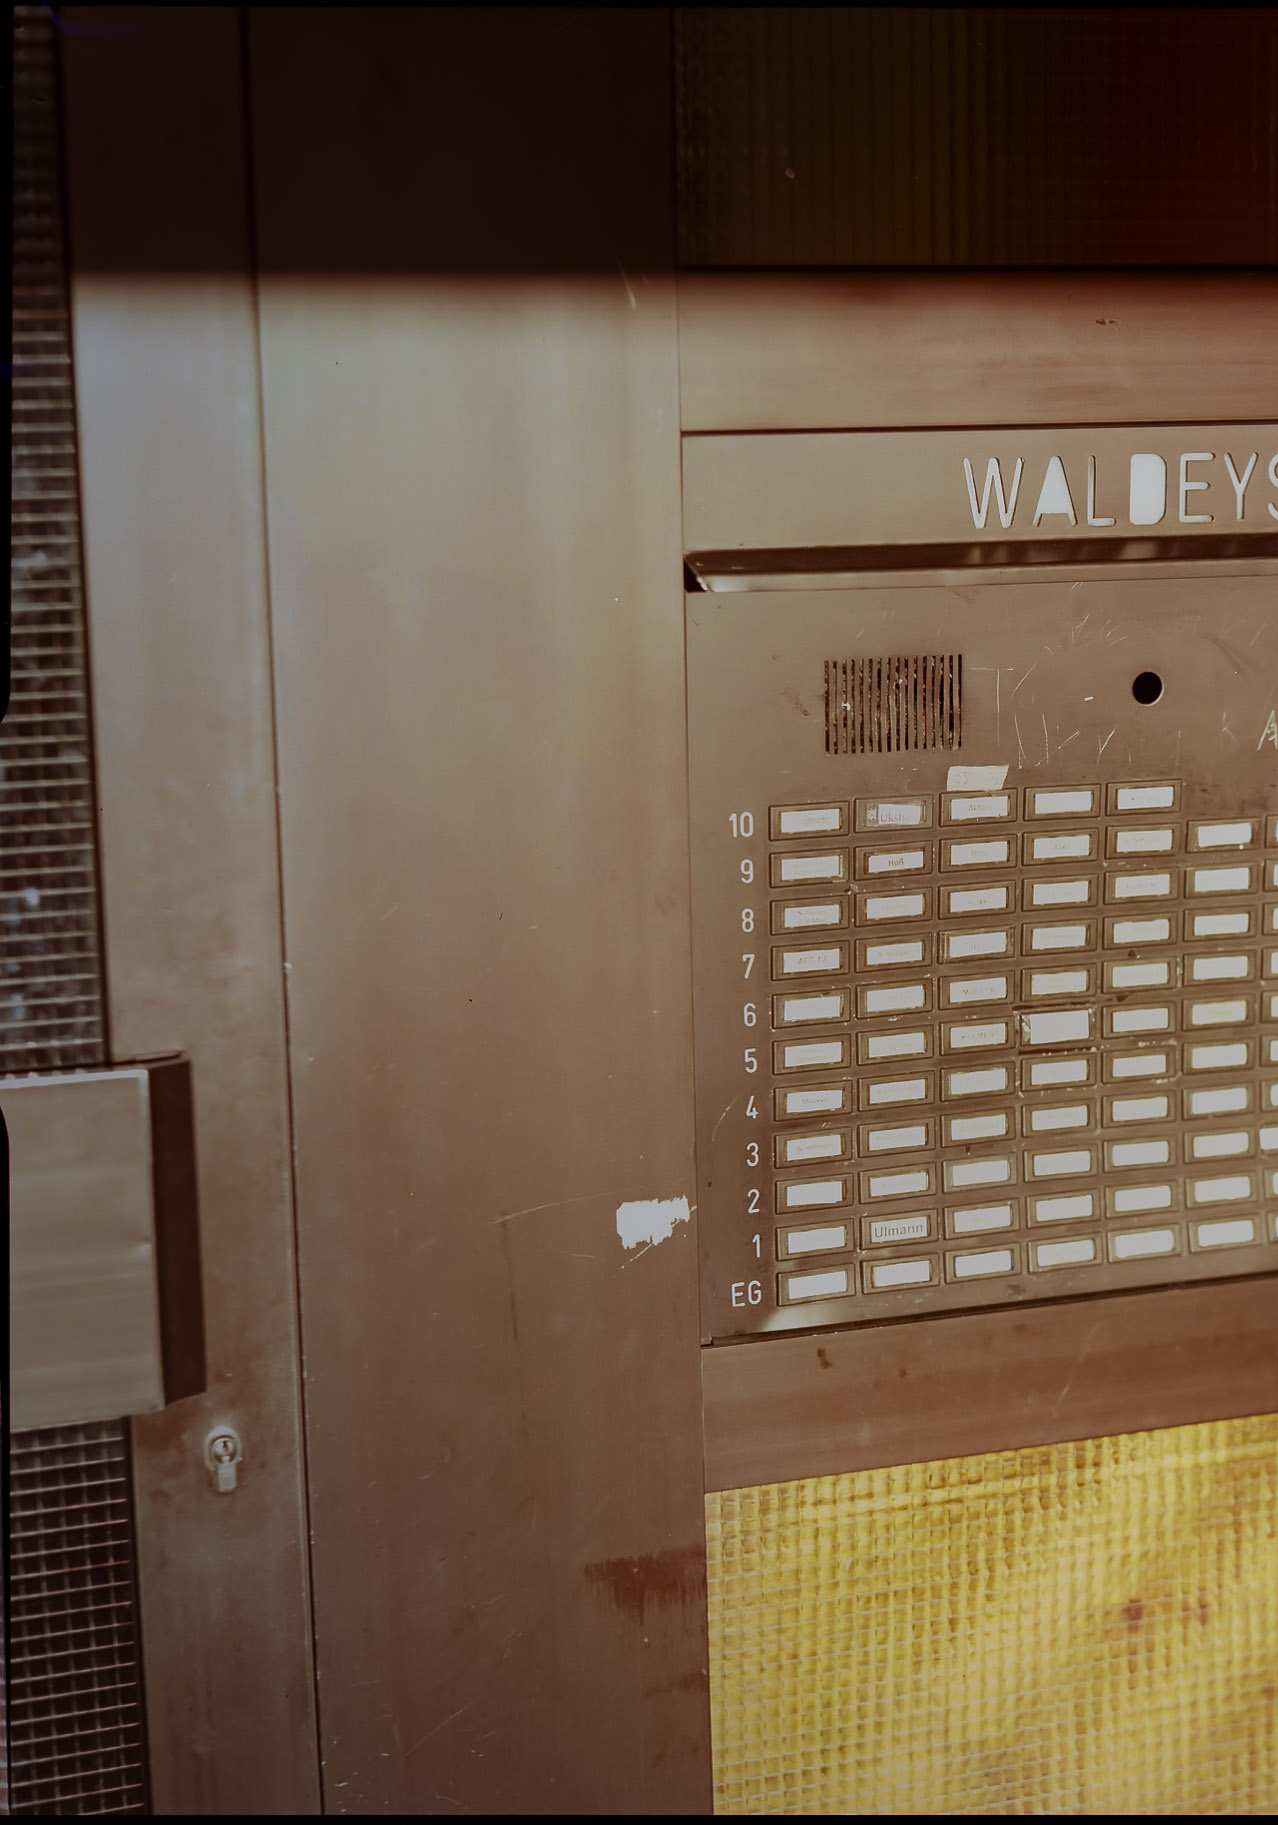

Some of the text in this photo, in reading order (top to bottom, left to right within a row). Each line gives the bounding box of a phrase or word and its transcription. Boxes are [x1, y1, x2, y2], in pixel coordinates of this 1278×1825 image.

[728, 811, 754, 838] 10
[740, 859, 754, 884] 9
[741, 908, 755, 933] 8
[742, 953, 756, 979] 7
[743, 1002, 757, 1027] 6
[744, 1048, 758, 1073] 5
[745, 1095, 759, 1119] 4
[746, 1142, 760, 1167] 3
[747, 1188, 760, 1214] 2
[874, 1224, 924, 1238] Ulmann
[752, 1233, 761, 1258] 1
[731, 1280, 762, 1307] EG
